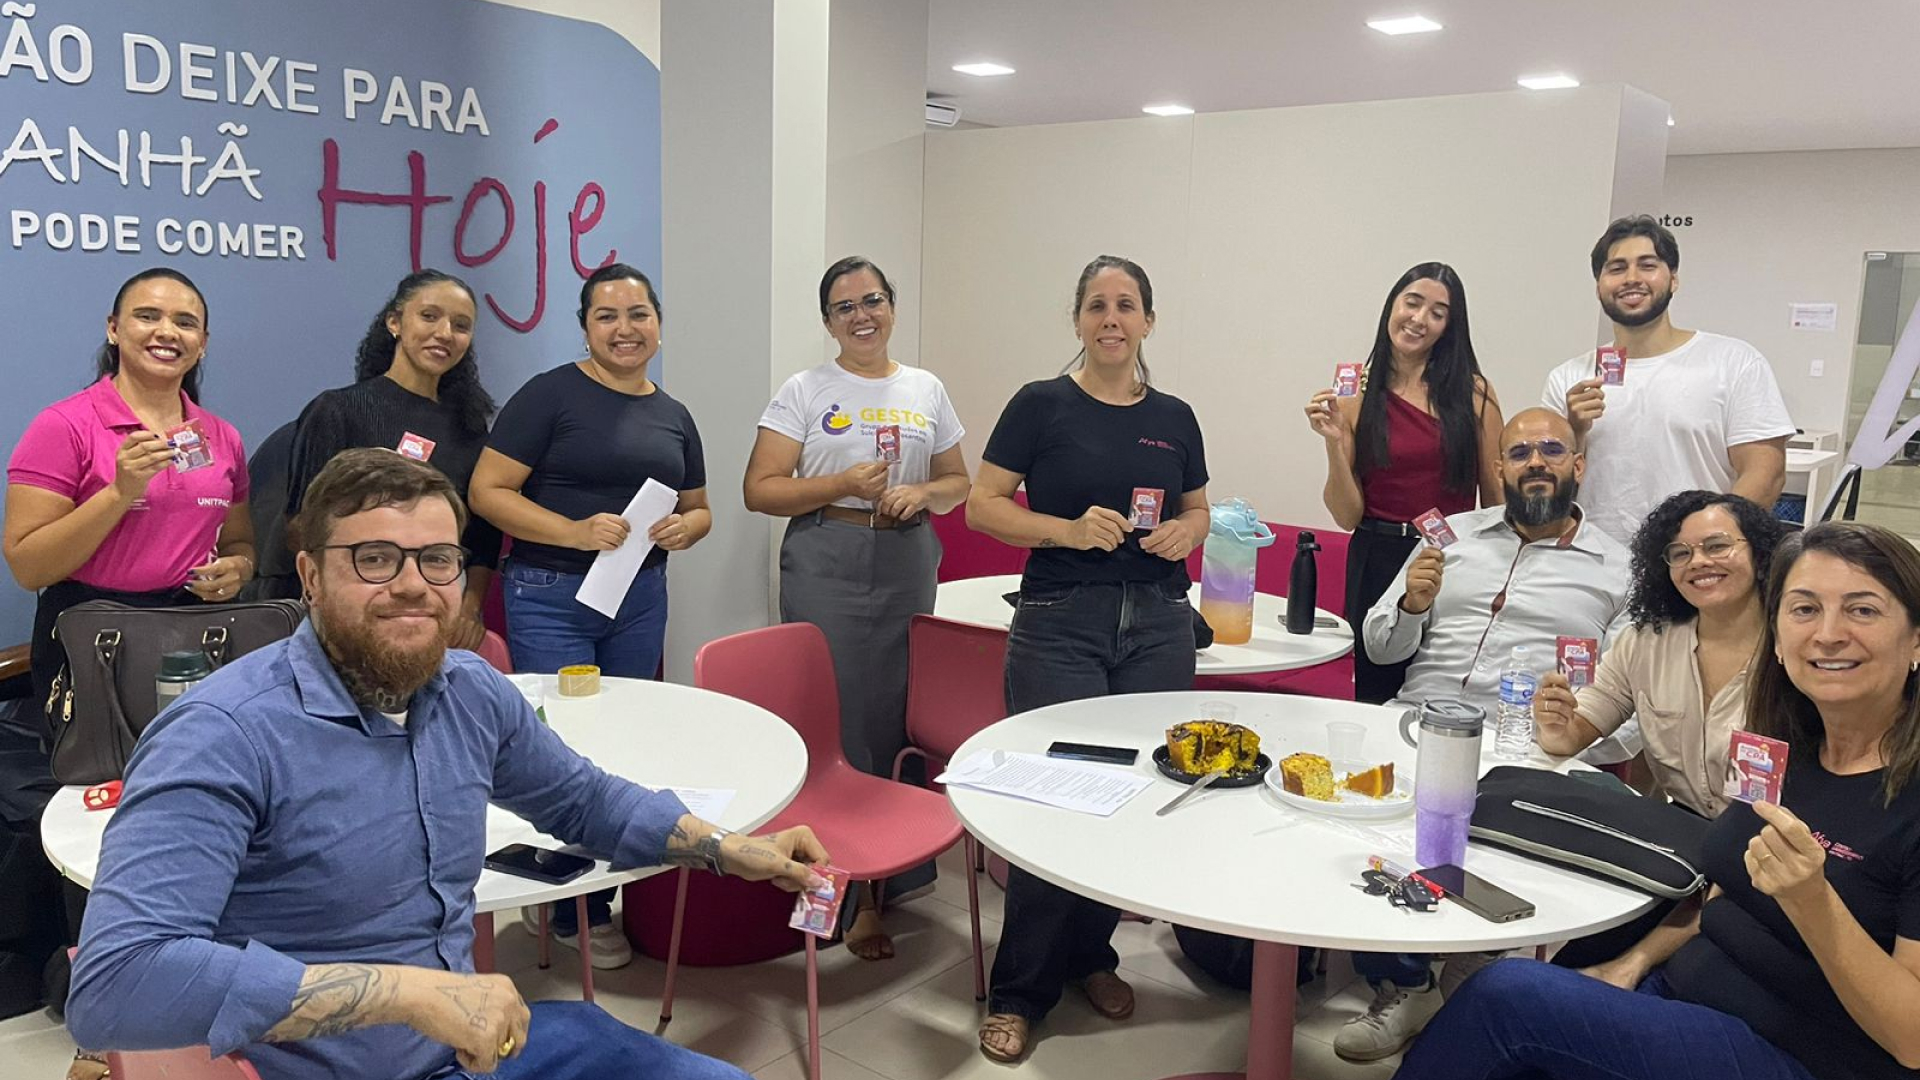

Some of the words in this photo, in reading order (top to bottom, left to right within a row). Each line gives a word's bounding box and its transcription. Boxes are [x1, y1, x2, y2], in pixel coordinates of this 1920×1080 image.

[0, 1, 93, 85] ÃO
[122, 32, 319, 114] DEIXE
[343, 68, 490, 137] PARA
[0, 118, 263, 200] ANHÃ
[11, 210, 141, 252] PODE
[156, 217, 306, 259] COMER
[318, 118, 618, 334] Hoje
[860, 407, 926, 428] GESTO
